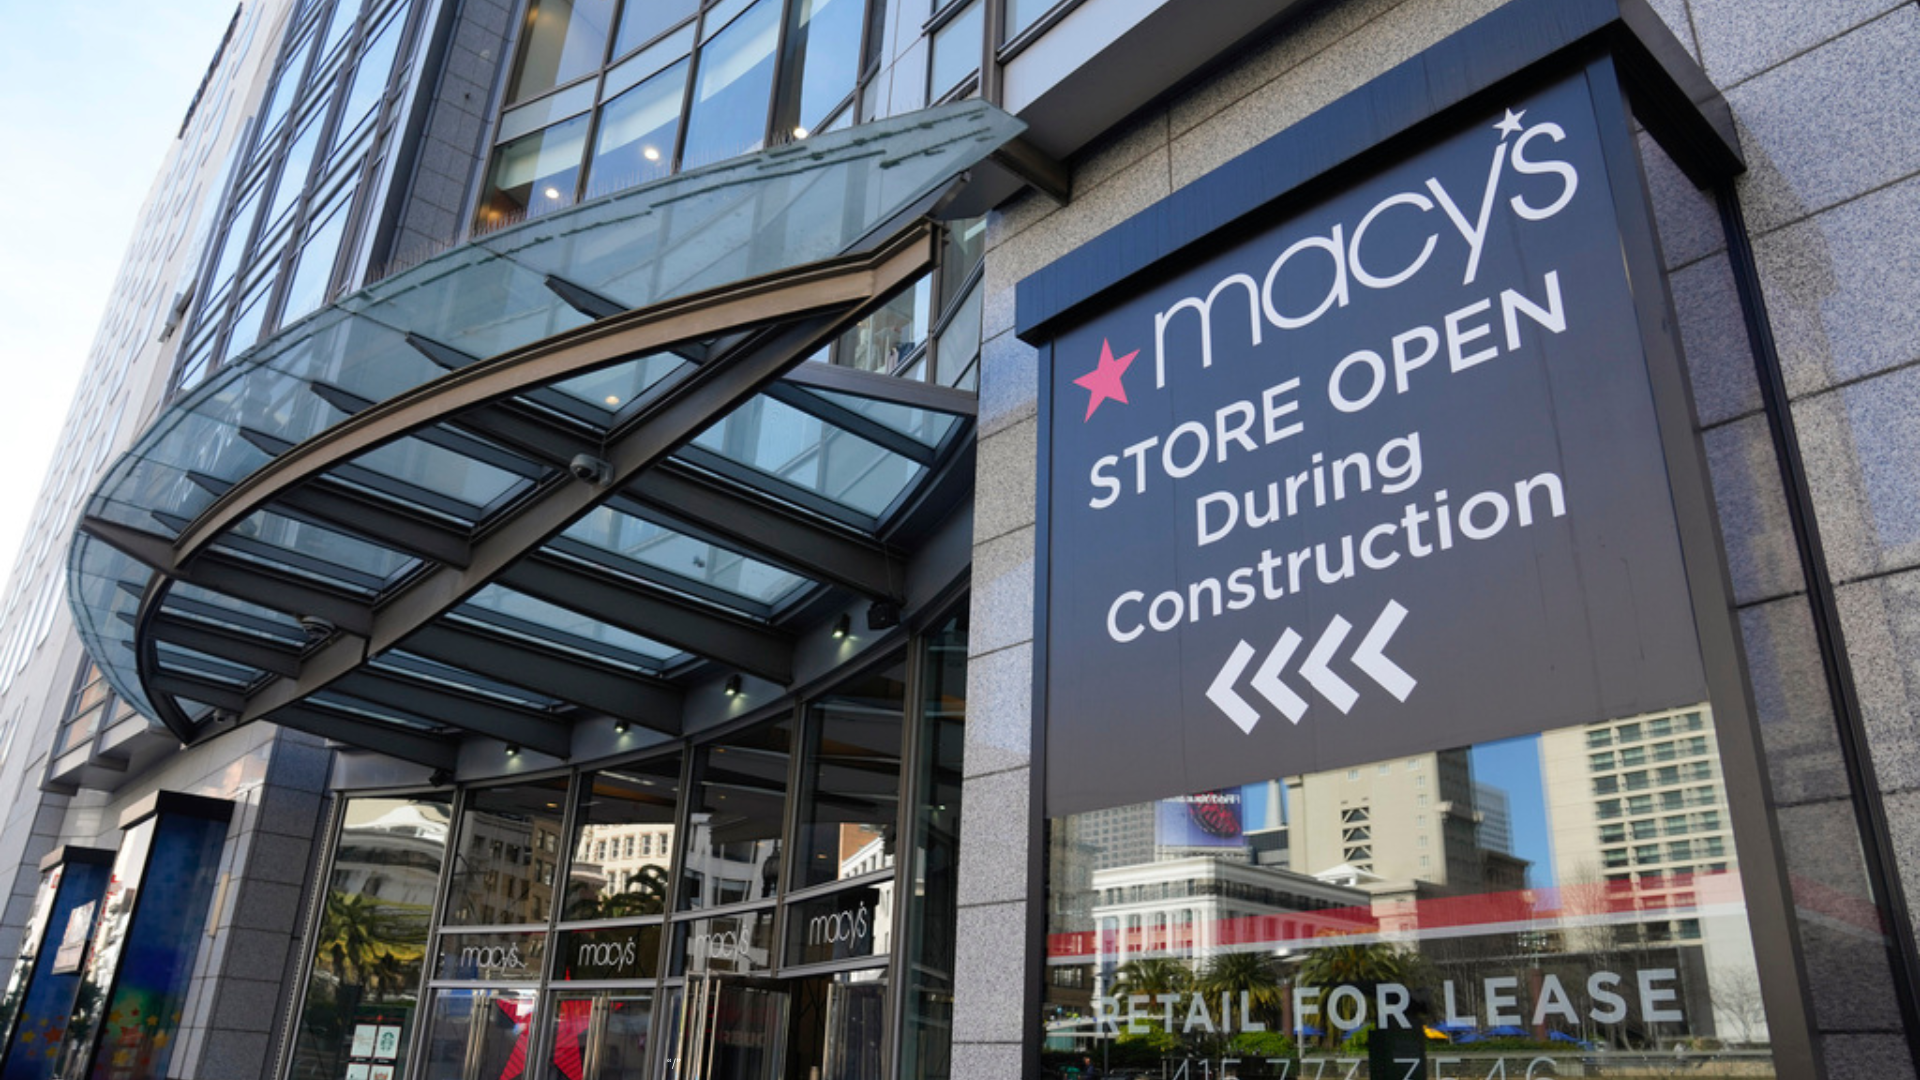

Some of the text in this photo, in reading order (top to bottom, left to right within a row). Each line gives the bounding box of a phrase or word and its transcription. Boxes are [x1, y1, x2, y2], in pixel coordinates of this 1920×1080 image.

[1088, 270, 1567, 509] STORE OPEN
[1106, 470, 1566, 643] Construction
[1196, 431, 1423, 547] During
[1097, 968, 1683, 1034] RETAIL FOR LEASE
